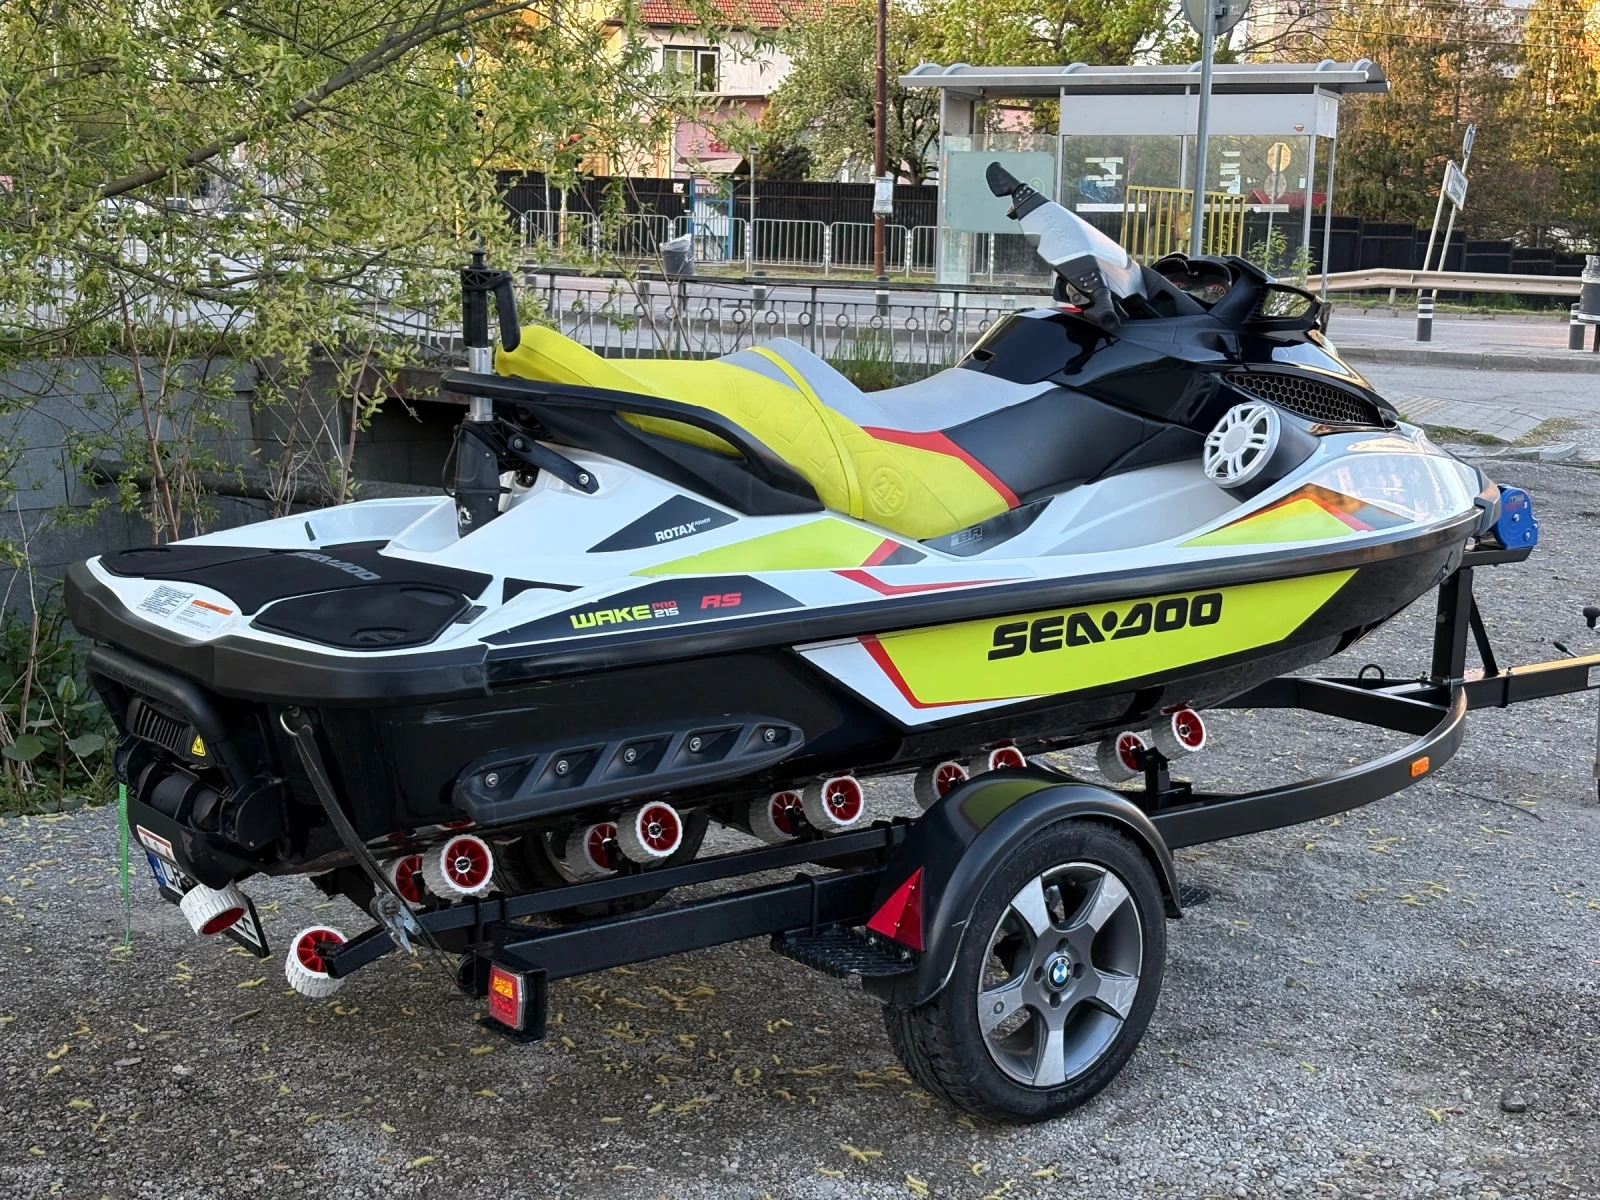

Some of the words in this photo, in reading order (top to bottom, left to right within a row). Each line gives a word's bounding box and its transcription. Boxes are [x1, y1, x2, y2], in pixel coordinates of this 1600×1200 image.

[654, 521, 697, 542] ROTAX
[694, 517, 711, 526] POWER
[651, 600, 678, 609] PRO
[700, 592, 742, 610] RS
[569, 604, 653, 629] WAKE
[653, 607, 680, 618] 215
